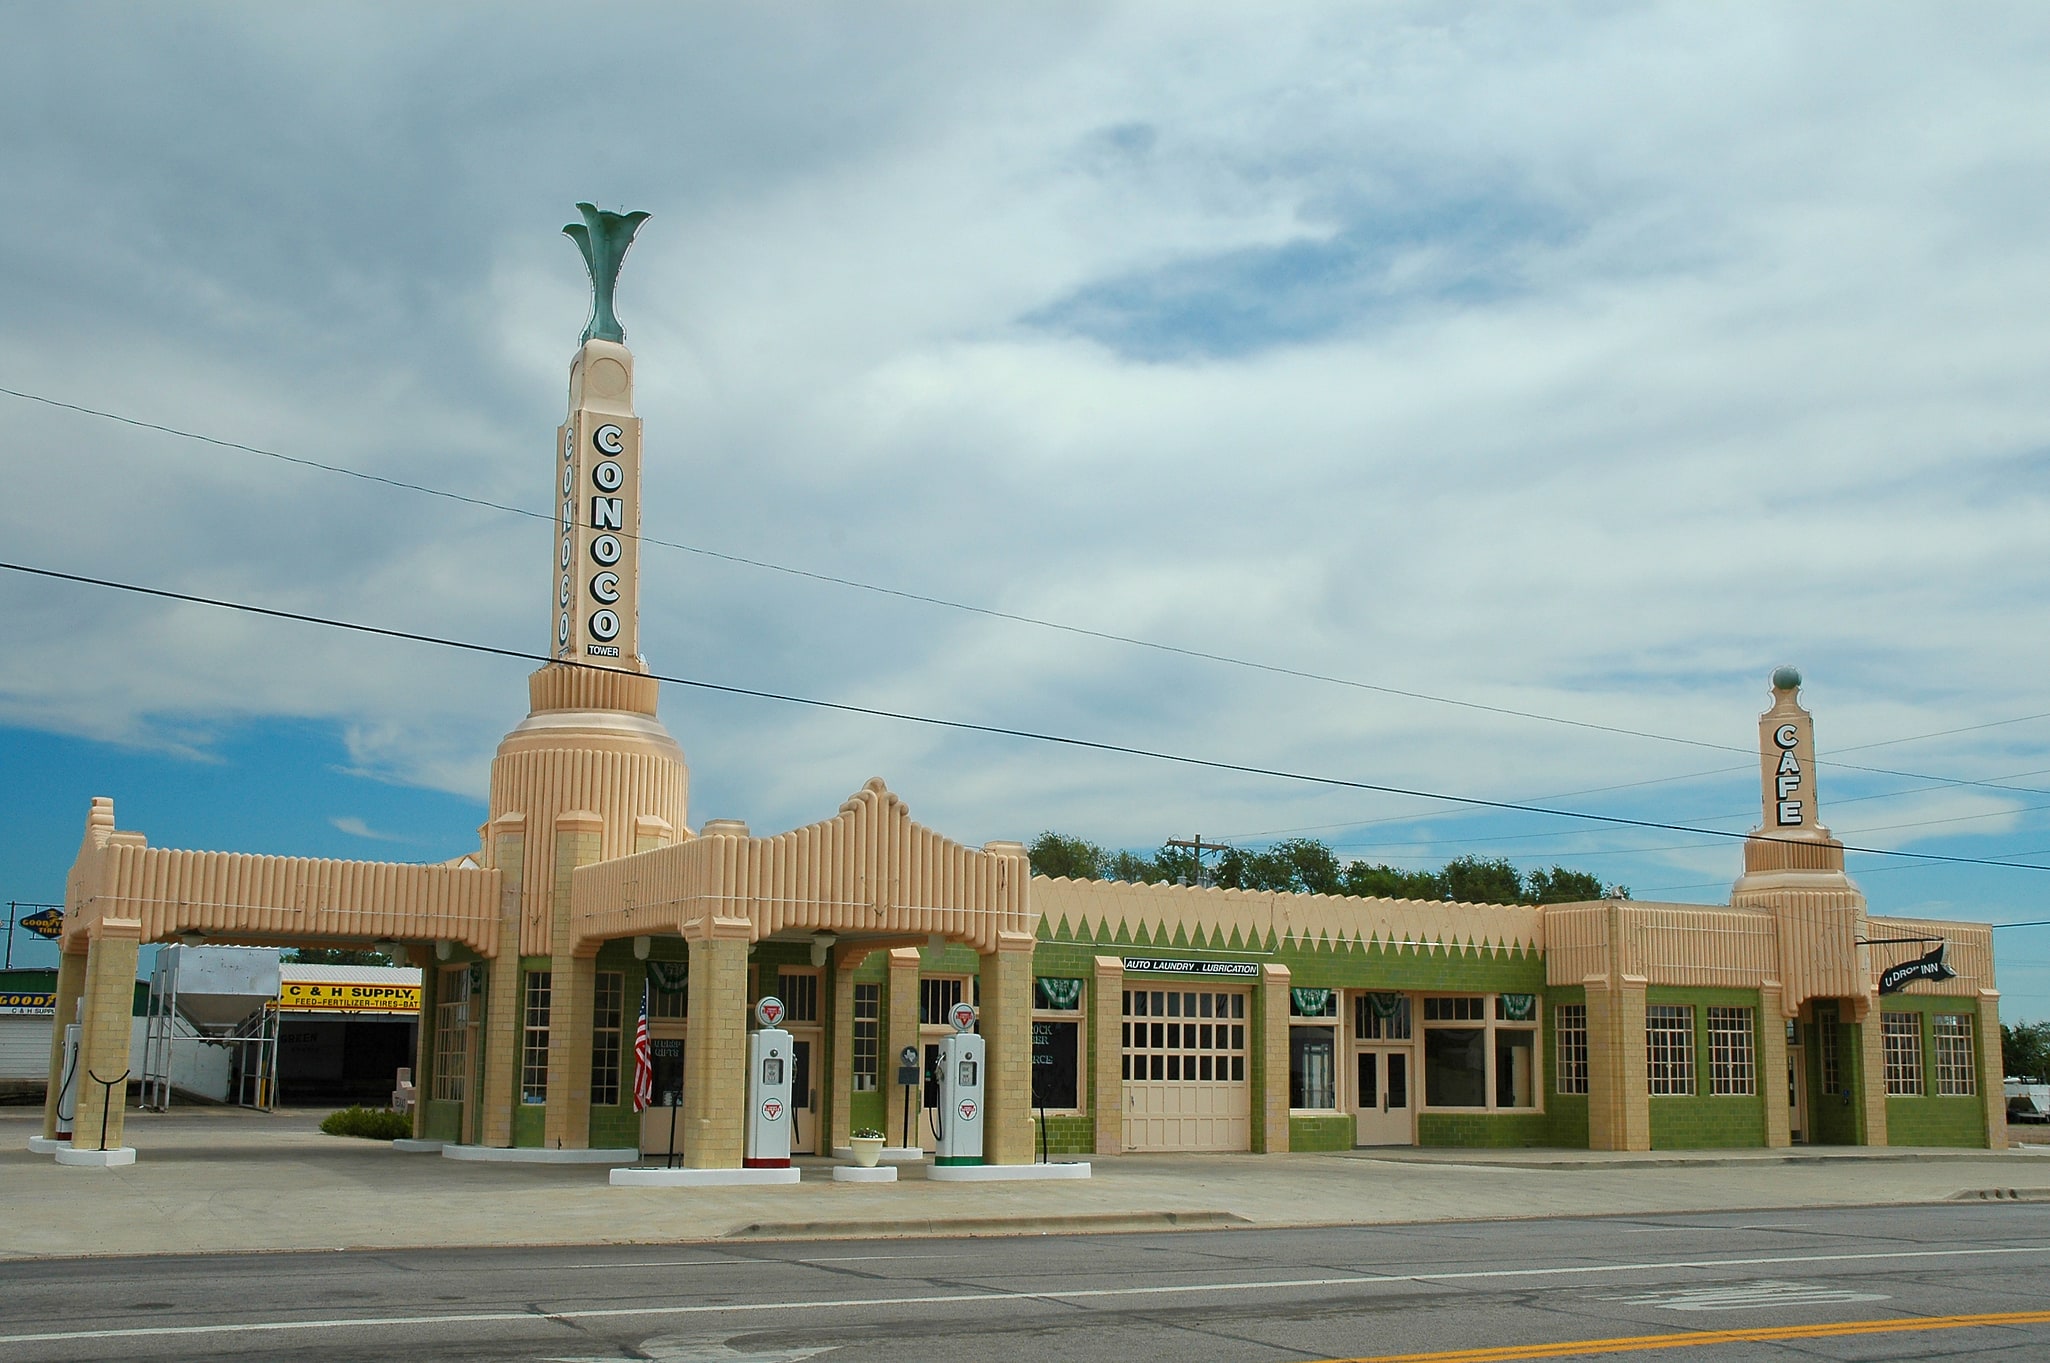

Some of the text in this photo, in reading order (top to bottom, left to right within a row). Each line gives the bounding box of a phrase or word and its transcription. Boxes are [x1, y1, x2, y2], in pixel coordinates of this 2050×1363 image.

[558, 427, 573, 647] CONOCO
[589, 424, 624, 643] CONOCO
[588, 646, 619, 657] TOWER
[1773, 723, 1803, 826] CAFE
[1126, 960, 1257, 974] AUTO LAUNDRY LUBRICATION
[1885, 976, 1893, 987] U
[1920, 962, 1939, 975] INN
[289, 986, 415, 1001] C & H SUPPLY,
